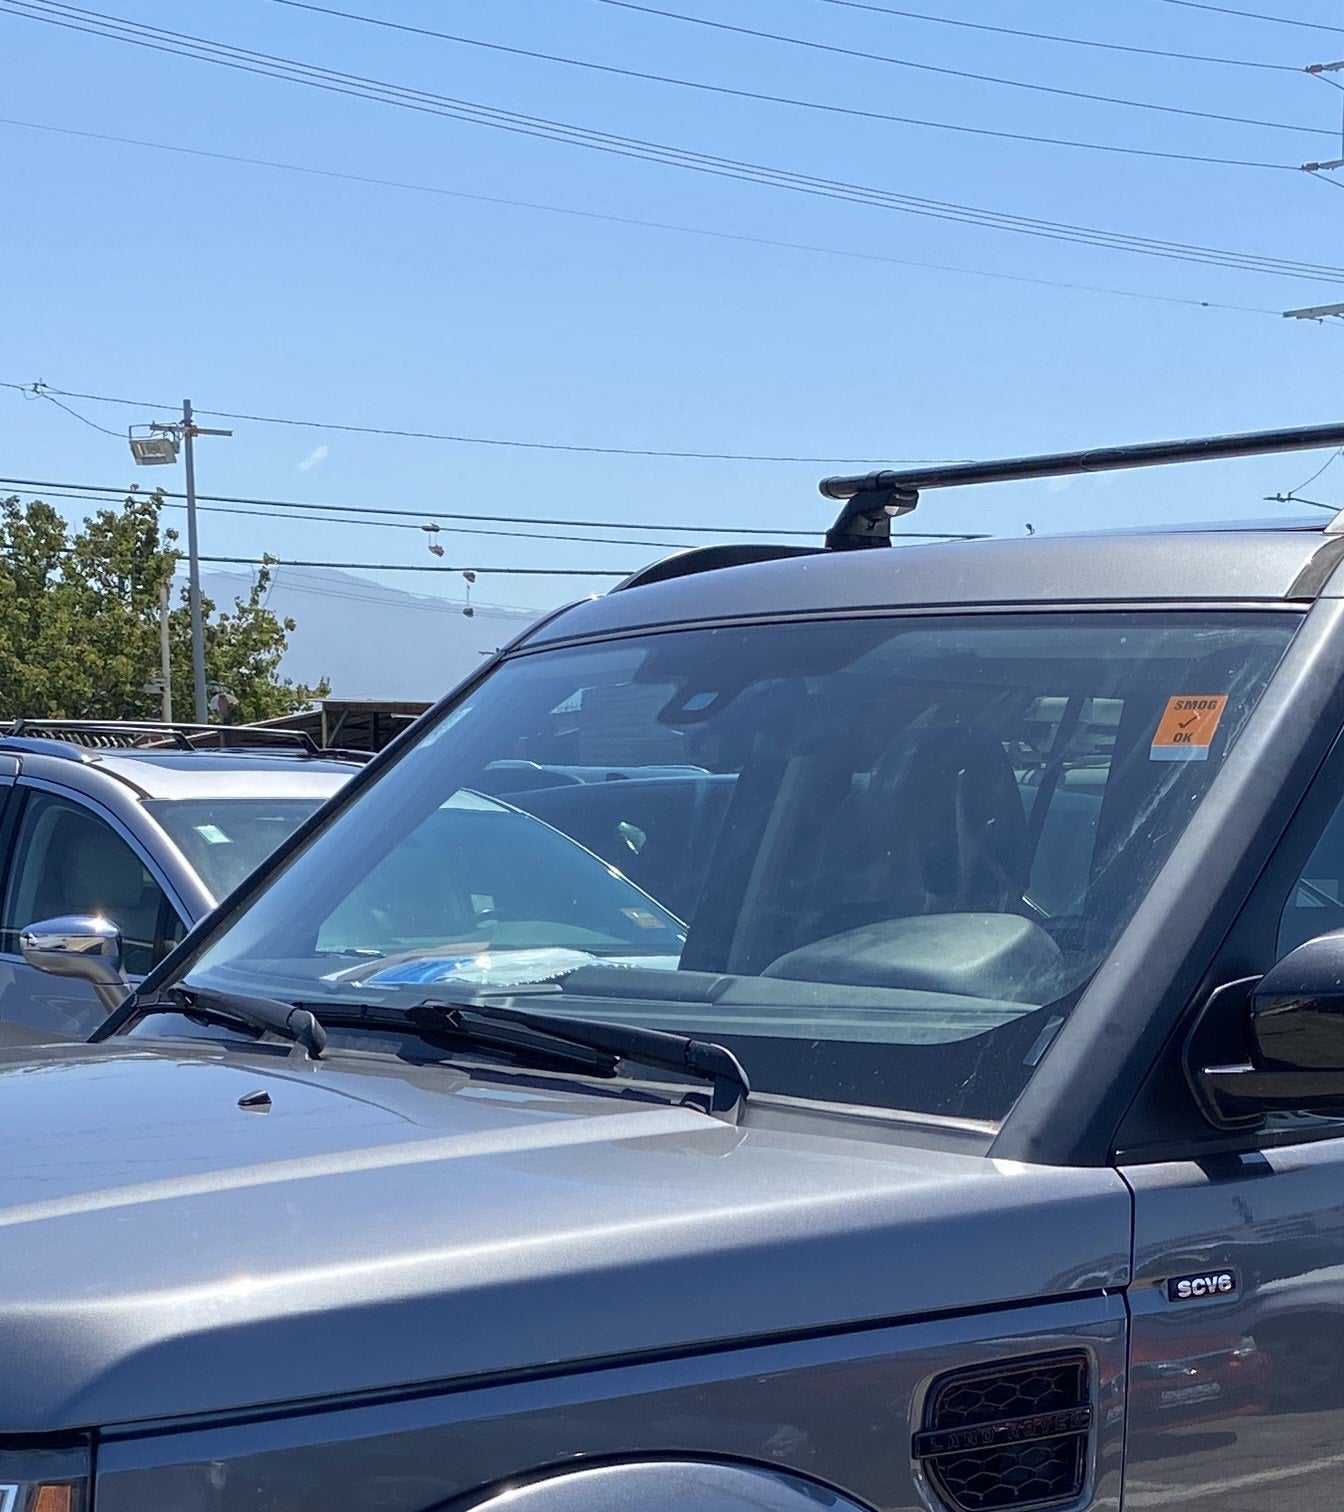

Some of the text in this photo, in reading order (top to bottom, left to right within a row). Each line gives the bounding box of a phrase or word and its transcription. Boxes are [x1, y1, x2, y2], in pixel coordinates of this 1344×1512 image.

[1173, 700, 1218, 710] SMOG
[1173, 732, 1194, 743] OK
[1178, 1275, 1232, 1297] SCV6
[931, 1411, 1090, 1452] LAND ROVER
